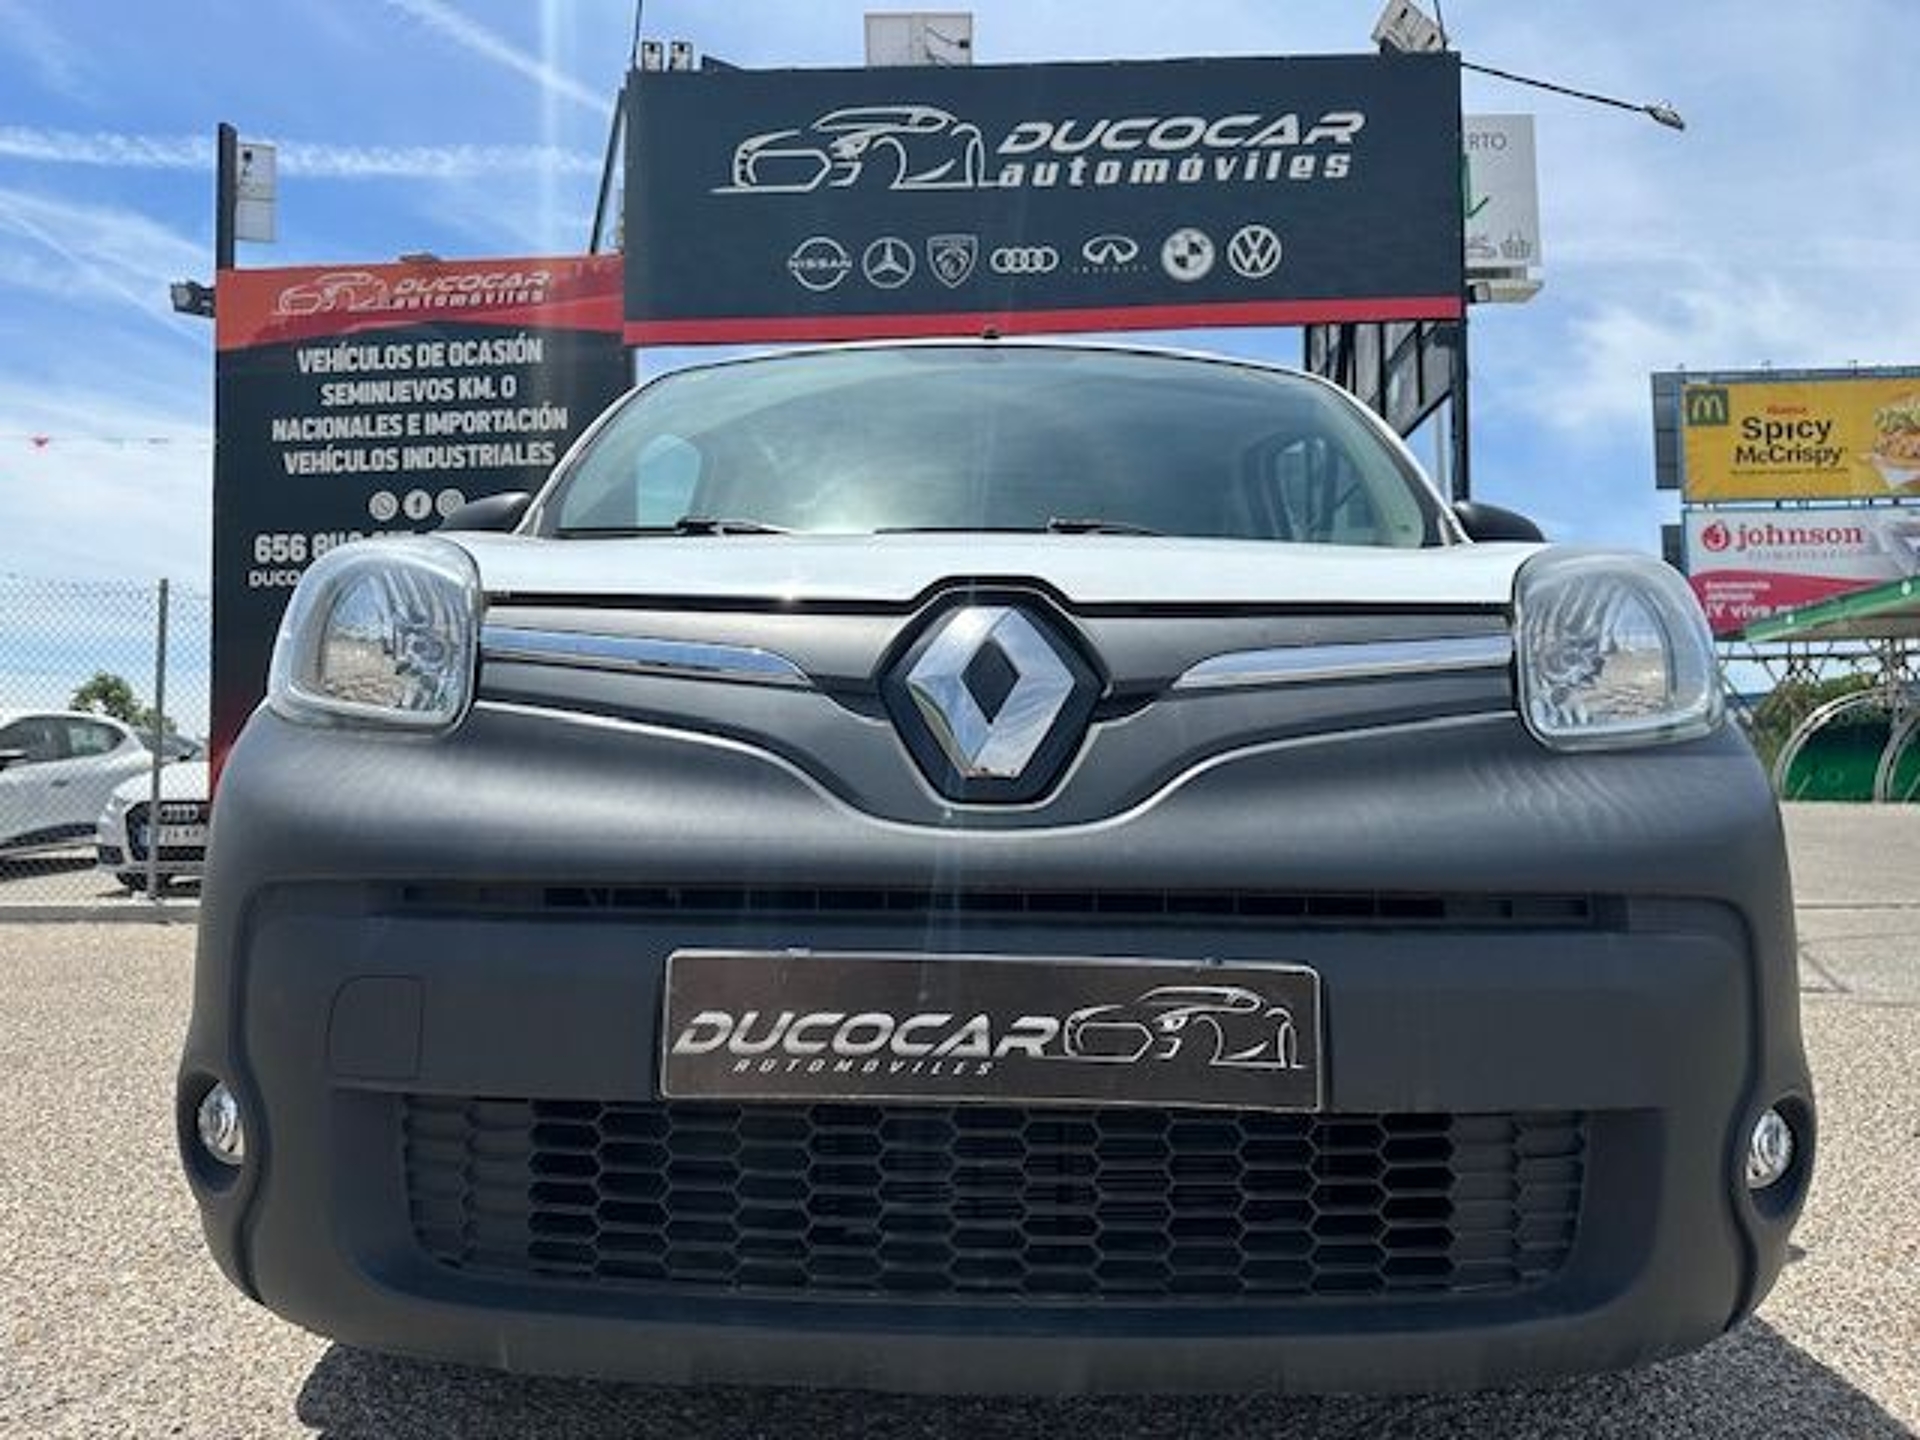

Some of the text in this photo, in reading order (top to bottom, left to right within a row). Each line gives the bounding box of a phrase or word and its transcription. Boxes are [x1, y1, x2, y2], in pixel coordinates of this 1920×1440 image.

[996, 111, 1365, 154] DUCOCAR
[1000, 151, 1351, 188] automóviles
[394, 270, 551, 295] DUCOCAR
[297, 332, 544, 373] VEHÍCULOS DE OCASIÓN
[320, 377, 455, 406] SEMINUEVOS
[458, 376, 497, 401] KM.
[271, 401, 568, 442] NACIONALES E IMPORTACIÓN
[1741, 416, 1833, 445] Spicy
[283, 441, 556, 475] VEHÍCULOS INDUSTRIALES
[1736, 442, 1842, 466] McCrispy
[254, 534, 307, 563] 656
[1736, 524, 1863, 551] johnson
[671, 1010, 1061, 1057] DUCOCAR
